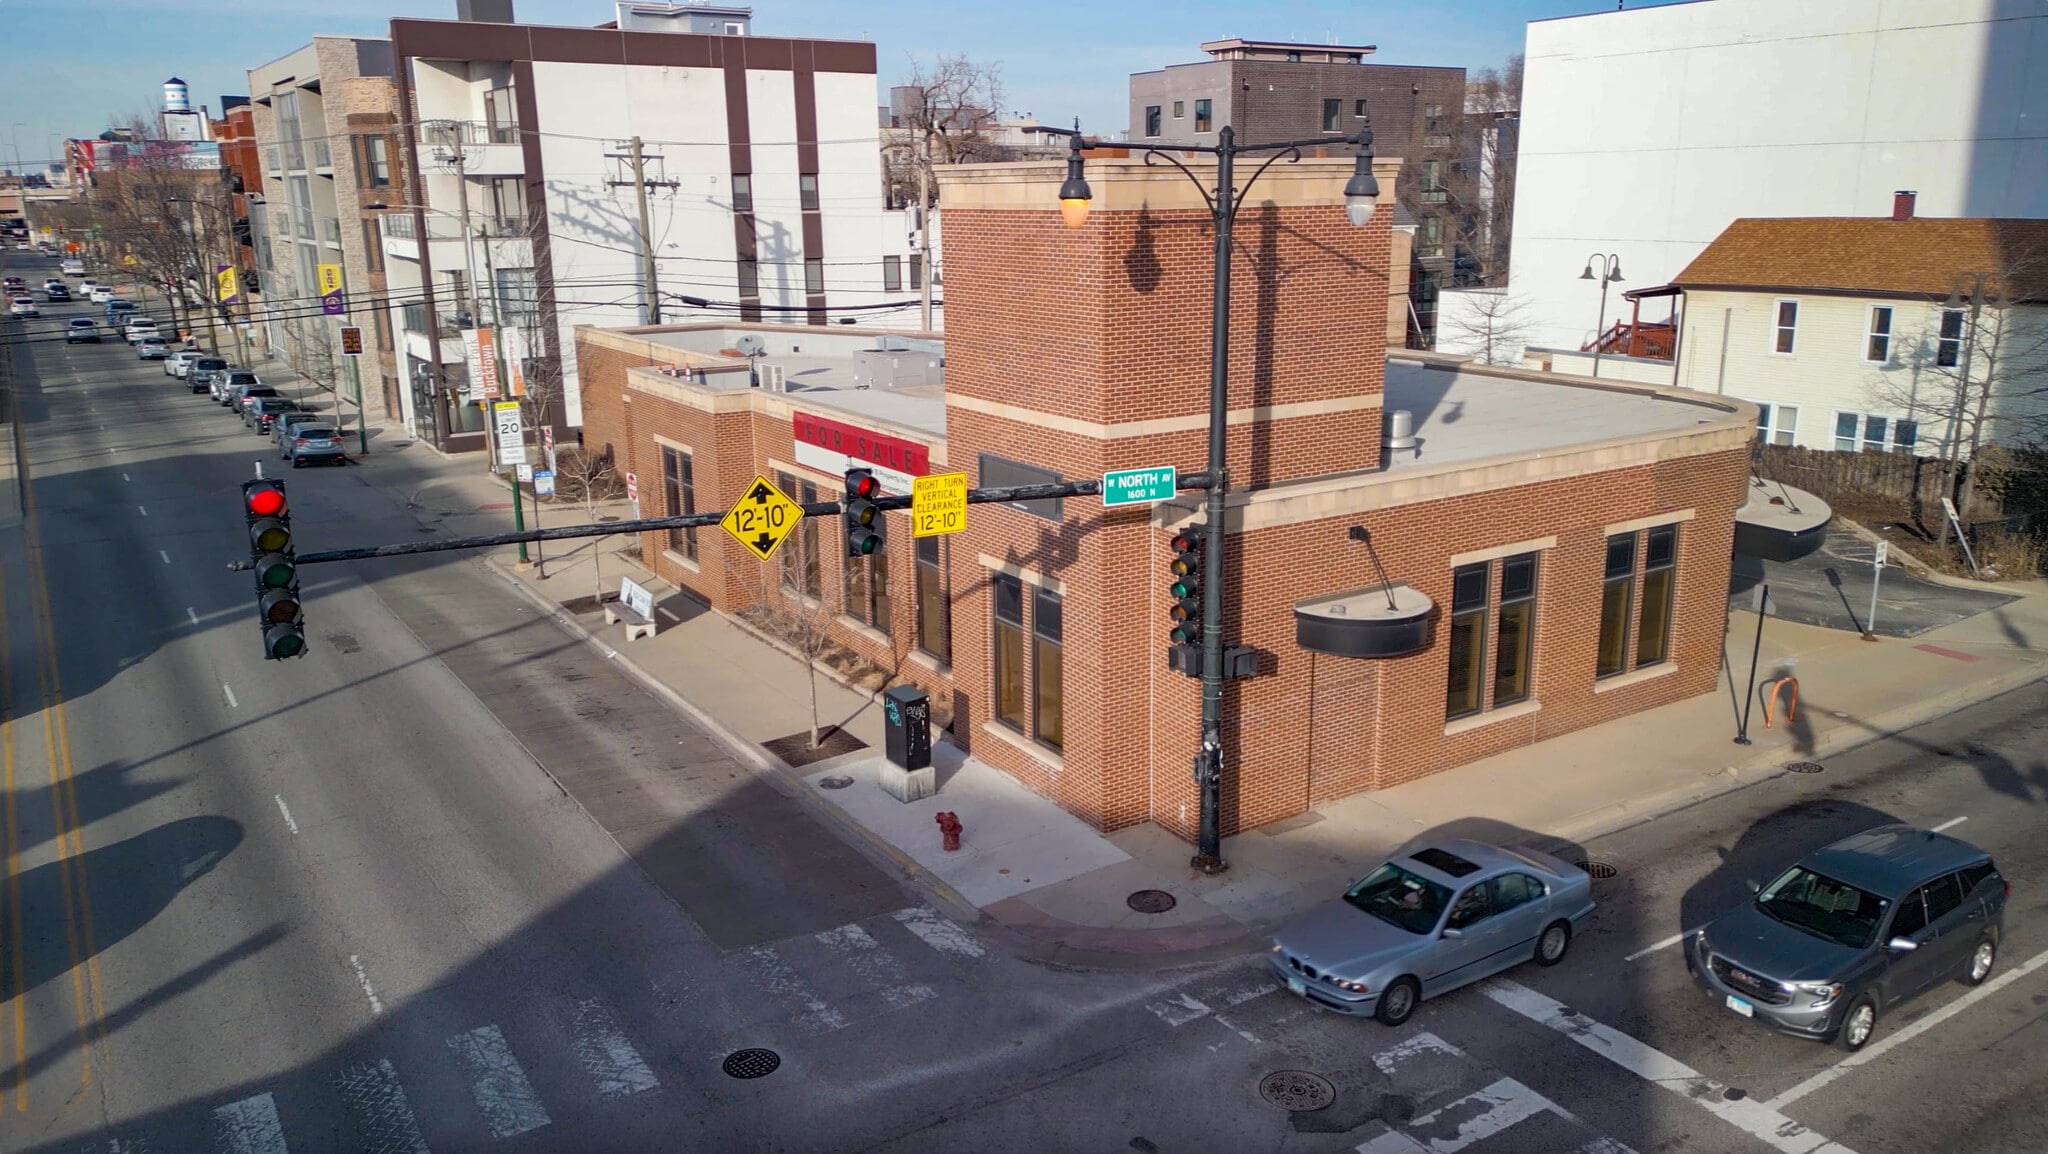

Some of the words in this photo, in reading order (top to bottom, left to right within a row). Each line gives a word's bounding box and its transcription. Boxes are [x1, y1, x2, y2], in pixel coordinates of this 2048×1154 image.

[466, 339, 480, 360] Park
[482, 344, 497, 393] Bucktown
[500, 423, 519, 434] 20
[806, 422, 842, 449] FOR
[858, 436, 913, 472] SALE
[917, 479, 939, 491] RIGHT
[944, 477, 963, 488] TURN
[1107, 478, 1115, 487] W
[1118, 472, 1158, 488] NORTH
[1162, 473, 1172, 482] AV
[922, 488, 958, 501] VERTICAL
[1127, 489, 1146, 499] 1600
[1150, 488, 1156, 497] N
[916, 498, 963, 514] CLEARANCE
